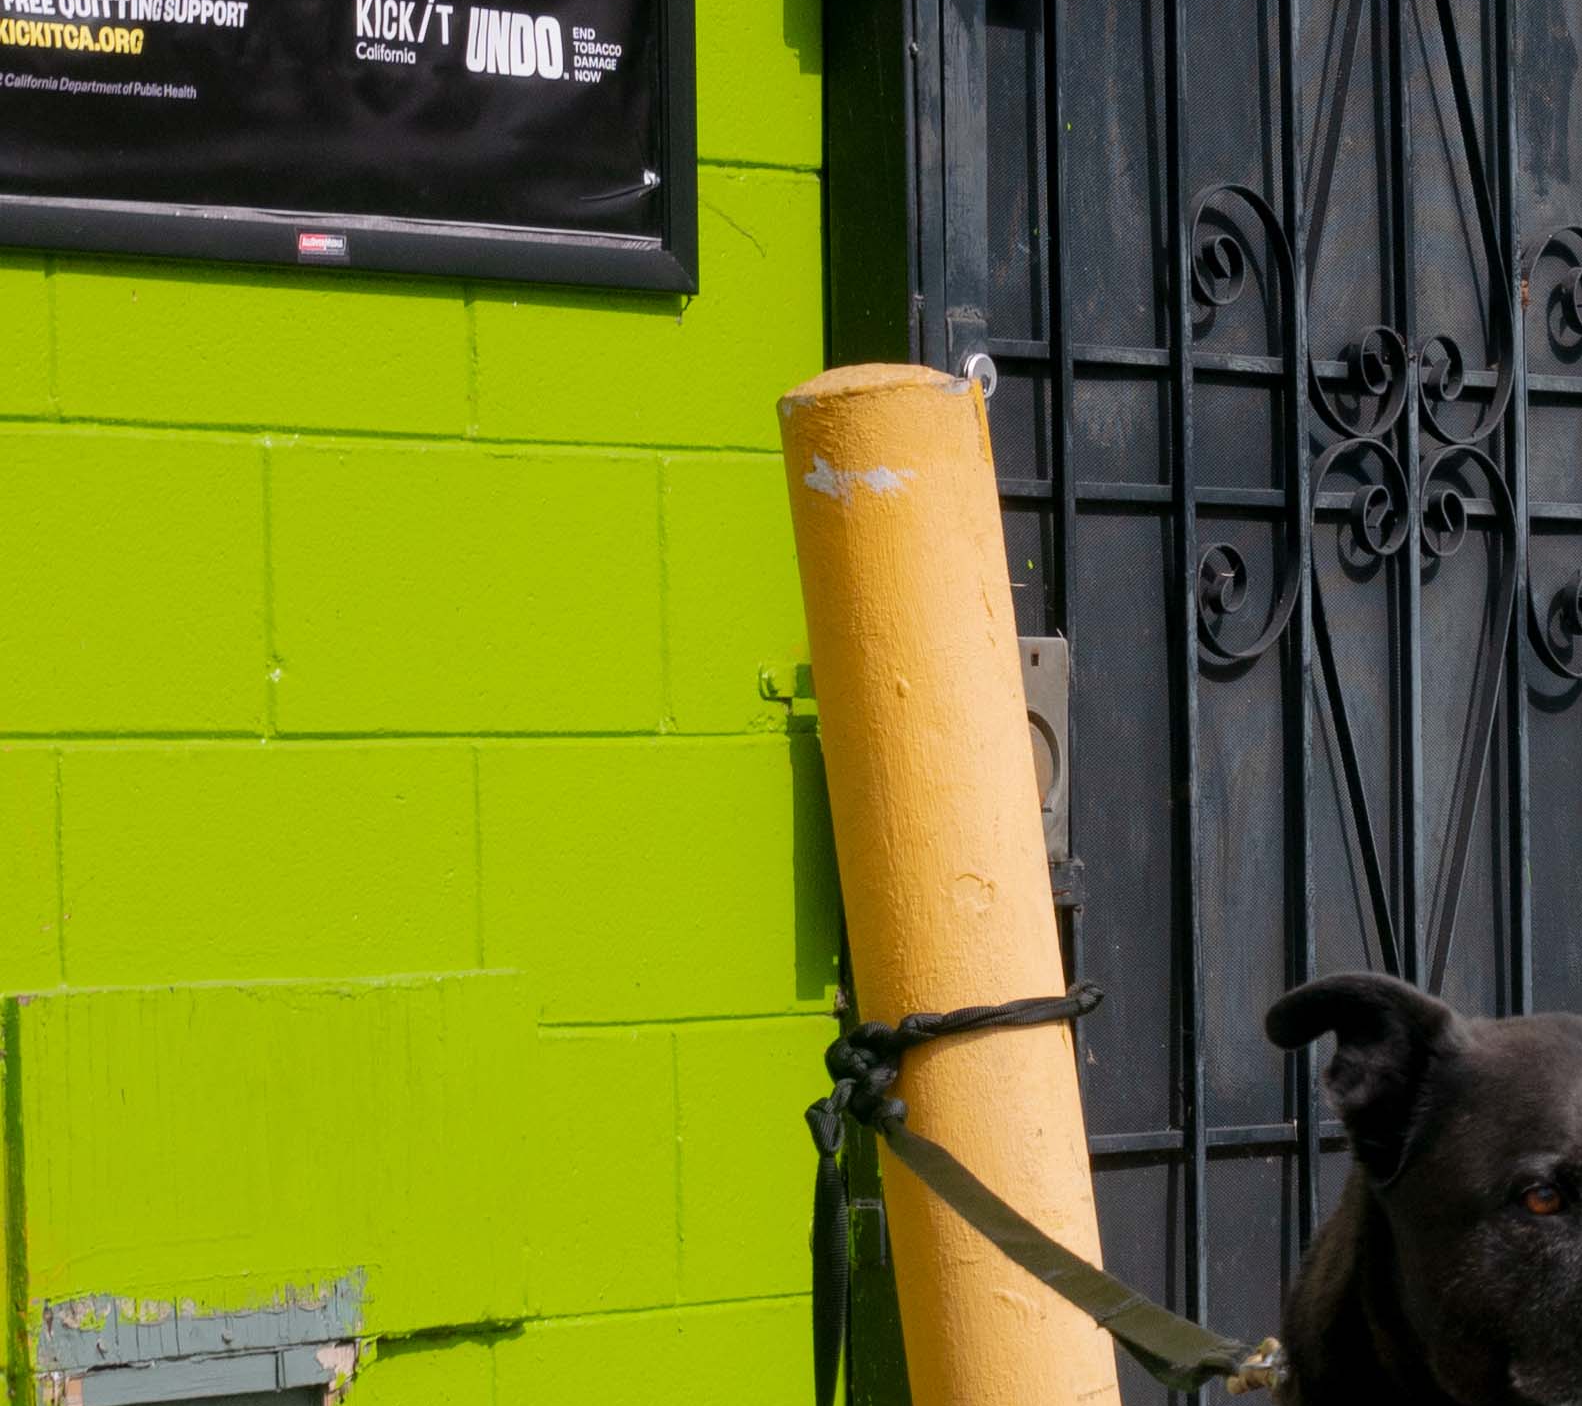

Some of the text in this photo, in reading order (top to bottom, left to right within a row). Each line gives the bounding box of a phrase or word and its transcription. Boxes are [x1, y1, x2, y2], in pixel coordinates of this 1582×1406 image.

[572, 27, 595, 40] END
[355, 42, 416, 64] California
[573, 41, 621, 58] TOBACCO
[574, 56, 617, 71] DAMAGE
[575, 69, 602, 83] NOW
[4, 73, 58, 90] California
[60, 77, 122, 95] Department
[122, 82, 134, 93] of
[134, 82, 163, 98] Public
[164, 85, 197, 100] Health
